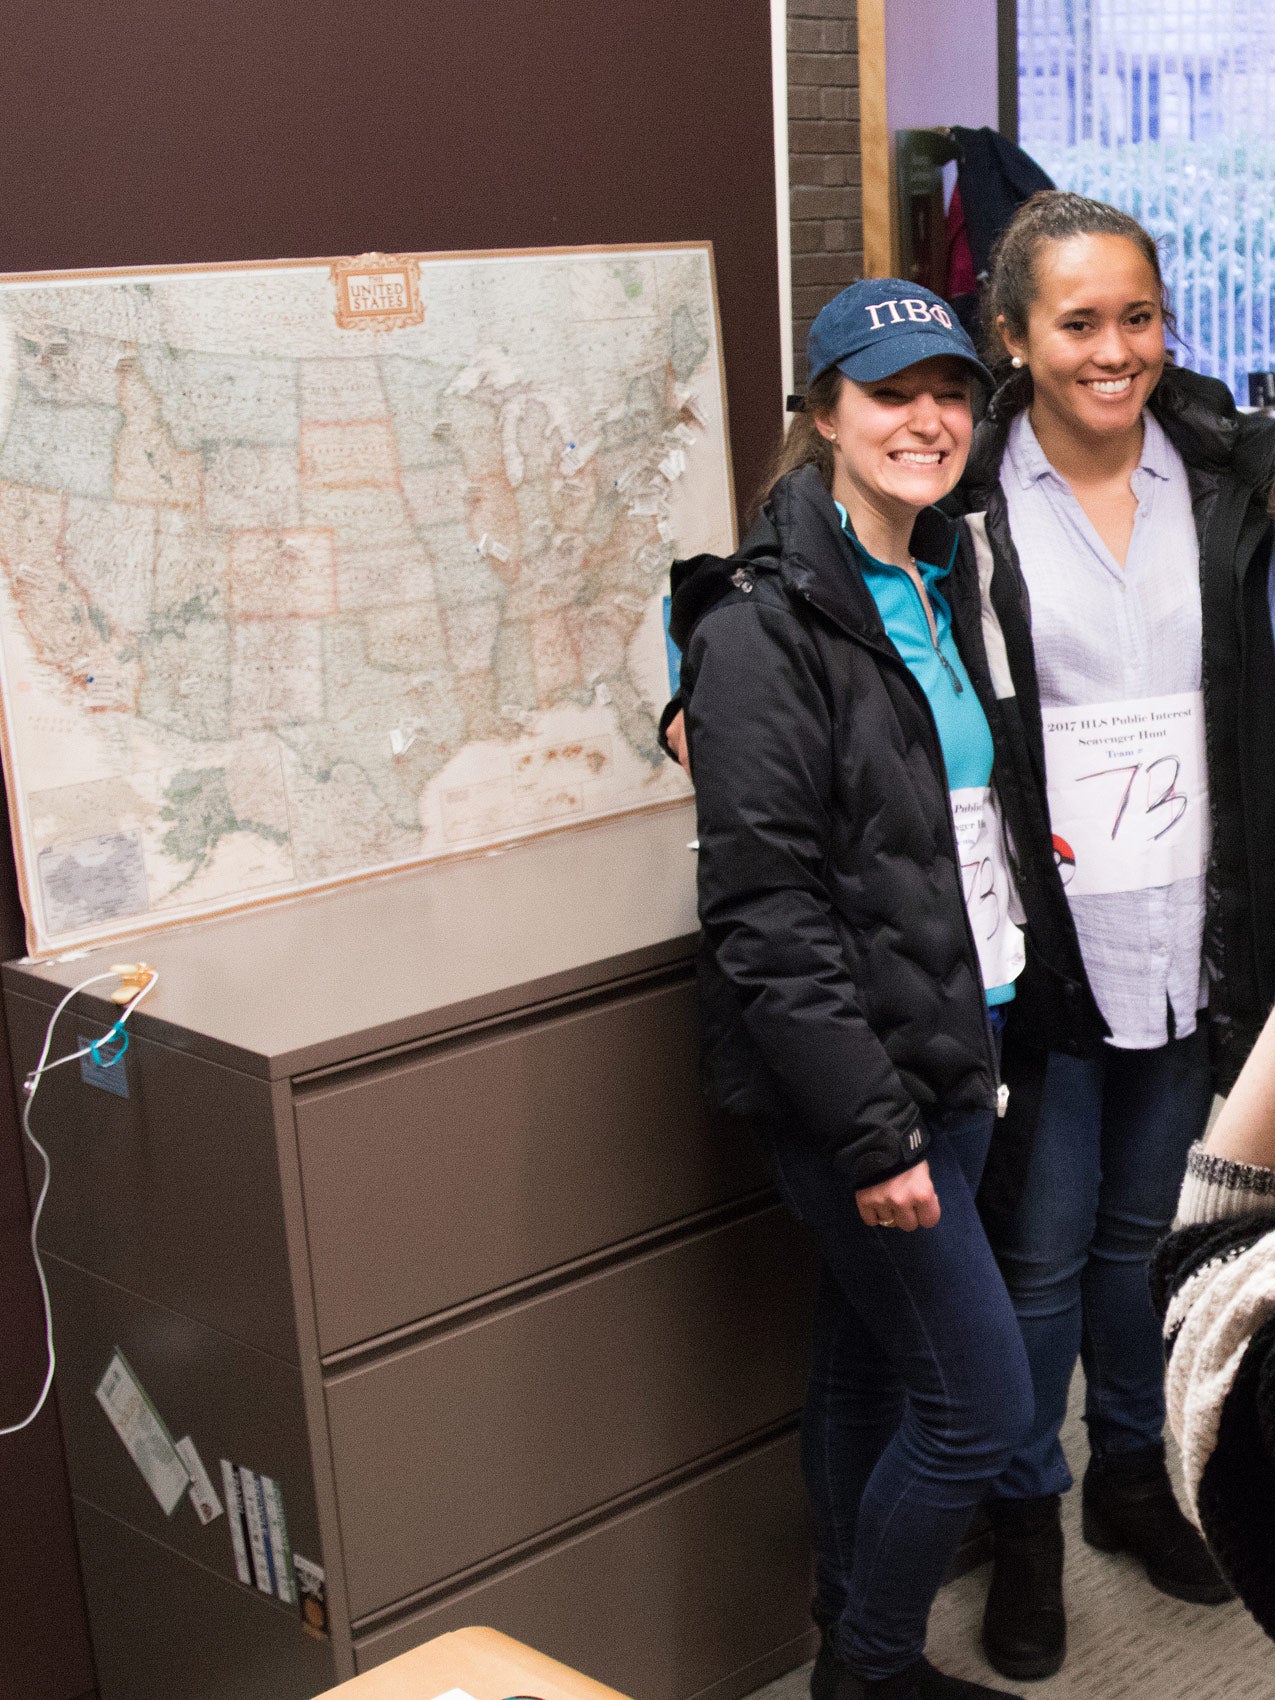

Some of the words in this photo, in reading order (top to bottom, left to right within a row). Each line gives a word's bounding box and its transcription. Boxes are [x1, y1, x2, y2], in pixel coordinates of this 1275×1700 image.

[351, 283, 403, 297] UNITED
[354, 295, 403, 309] STATES
[1047, 721, 1077, 733] 2017
[1080, 719, 1108, 730] HLS
[1111, 714, 1147, 726] Public
[1150, 708, 1192, 720] Interest
[1079, 733, 1136, 746] Scavenger
[1139, 729, 1167, 740] Hunt
[1075, 753, 1188, 841] 73
